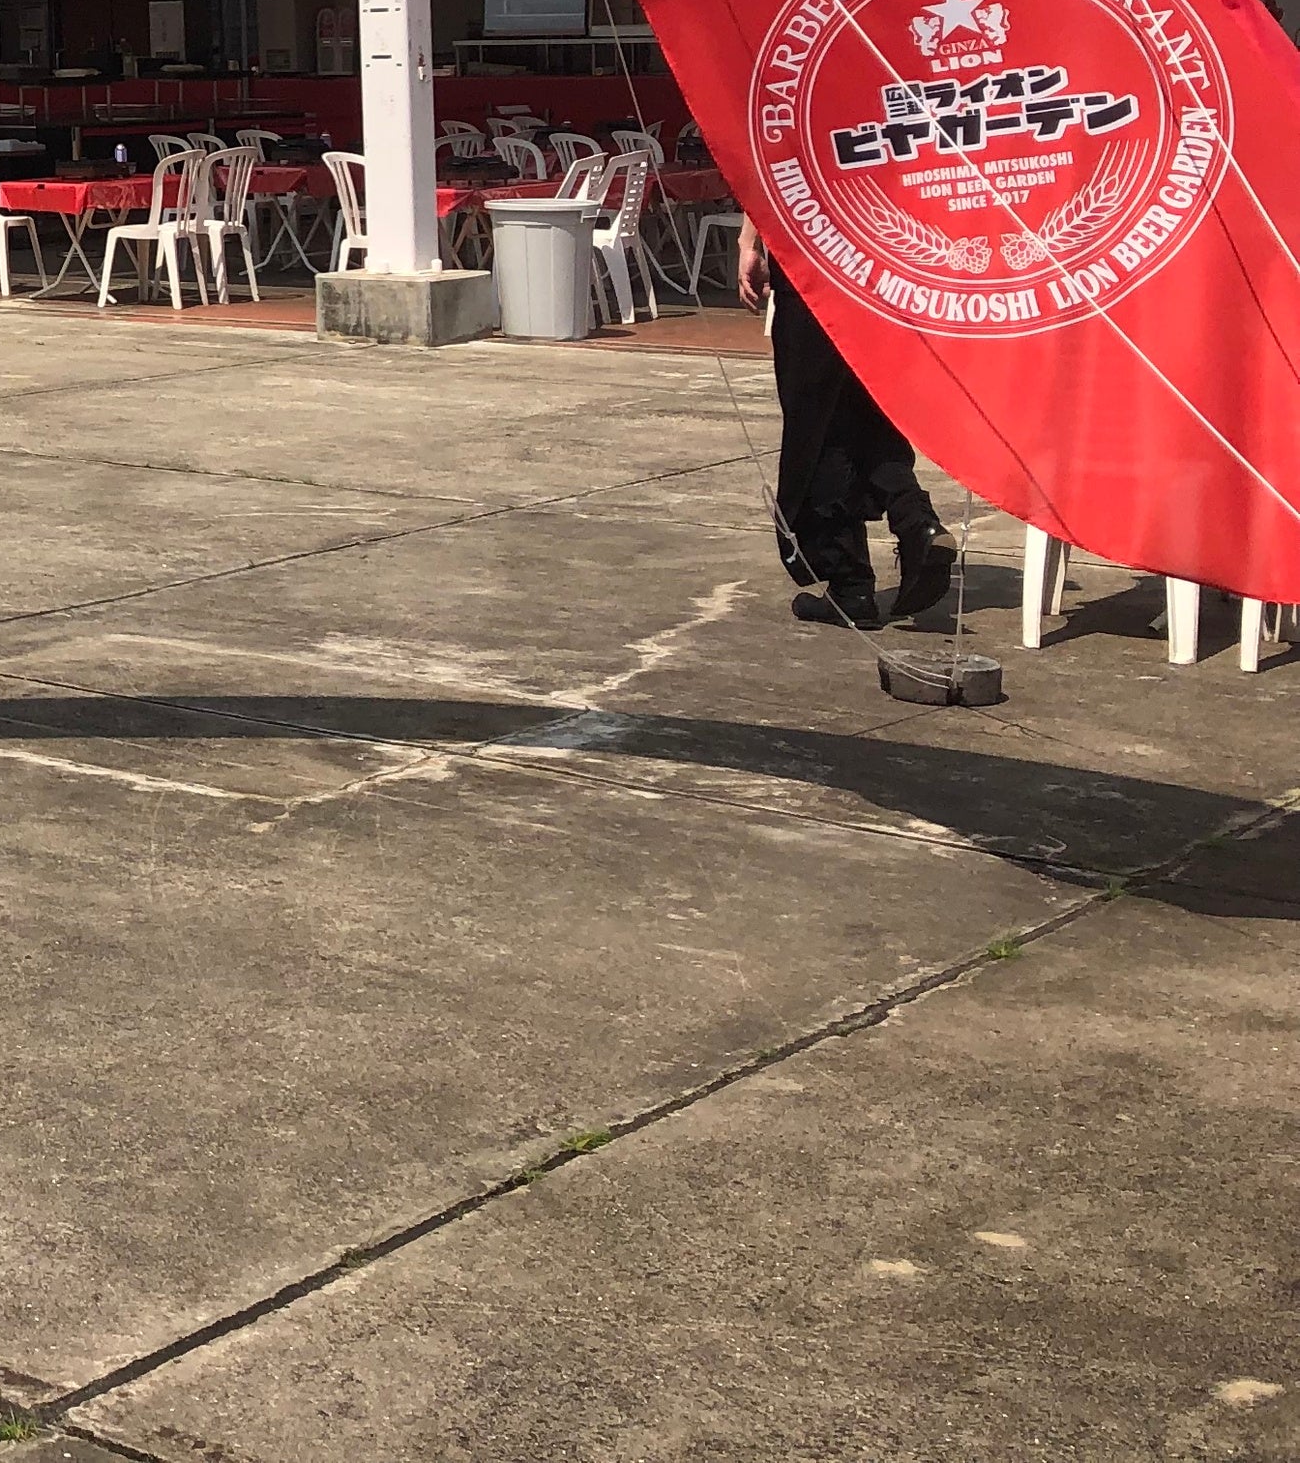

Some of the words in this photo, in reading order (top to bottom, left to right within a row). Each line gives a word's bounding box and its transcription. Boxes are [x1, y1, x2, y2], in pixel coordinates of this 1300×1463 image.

[930, 49, 1004, 73] LION
[939, 39, 990, 55] GINZA
[923, 68, 1063, 109] ライオン
[833, 95, 1133, 165] ビヤガーデン
[902, 166, 979, 188] HIROSHIMA
[984, 151, 1073, 175] MITSUKOSHI
[919, 182, 953, 199] LION
[956, 177, 991, 194] BEER
[995, 169, 1056, 189] GARDEN
[770, 157, 874, 290] HIROSHIMA
[874, 272, 1042, 324] MITSUKOSHI
[1048, 258, 1121, 310] LION
[1110, 201, 1182, 276] BEER
[1163, 105, 1218, 209] GARDEN
[947, 195, 988, 212] SINCE
[993, 190, 1029, 206] 2017
